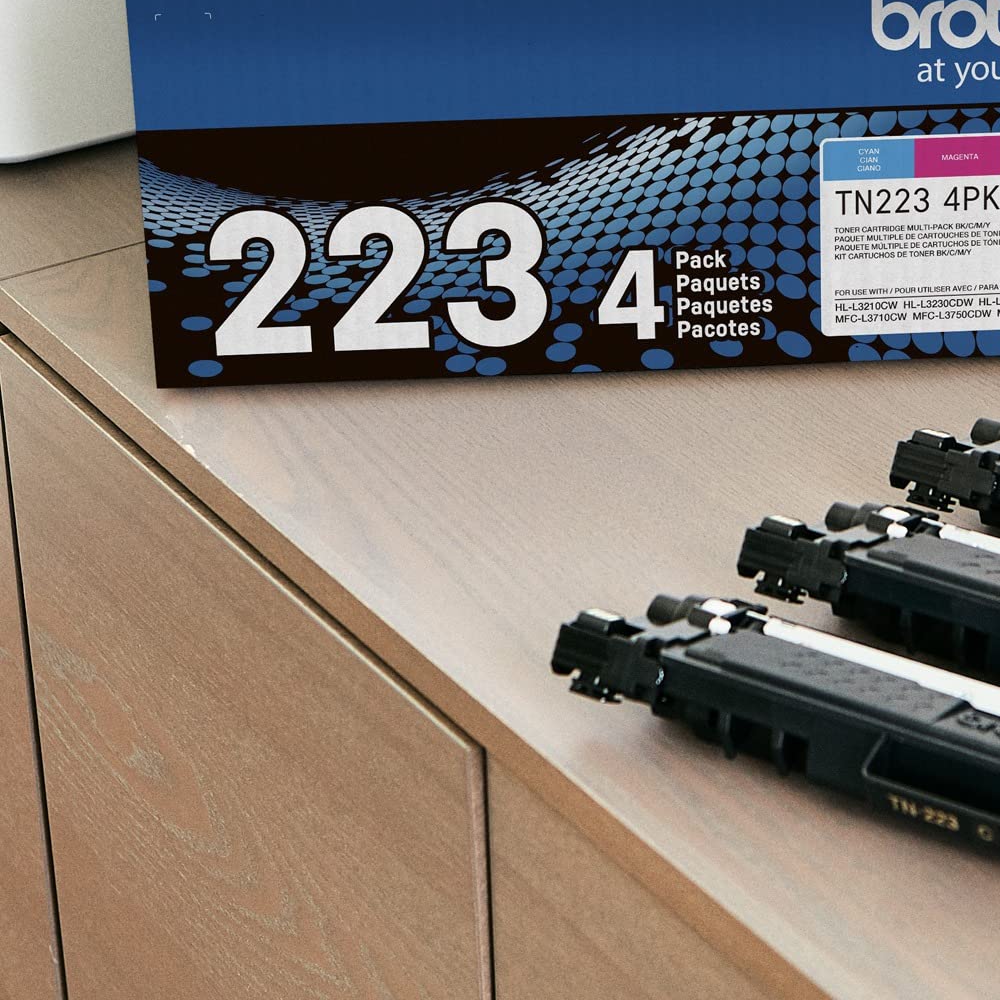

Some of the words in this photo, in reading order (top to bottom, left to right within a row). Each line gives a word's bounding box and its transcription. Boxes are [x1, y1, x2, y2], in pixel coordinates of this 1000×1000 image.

[917, 58, 946, 83] at
[858, 147, 881, 156] CYAN
[941, 153, 979, 161] MAGENTA
[859, 156, 879, 164] CIAN
[835, 187, 930, 216] TN223
[943, 184, 1000, 212] 4PK
[834, 226, 860, 234] TONER
[861, 224, 906, 233] CARTRIDGE
[907, 223, 953, 231] MULTI-PACK
[955, 222, 991, 230] BK/C/M/Y
[834, 234, 864, 242] PAQUET
[866, 233, 904, 241] MULTIPLE
[917, 231, 969, 239] CARTOUCHES
[834, 243, 870, 252] PAQUETE
[910, 241, 921, 249] DE
[922, 240, 969, 248] CARTUCHOS
[971, 239, 981, 247] DE
[675, 249, 727, 270] Pack
[847, 251, 896, 260] CARTUCHOS
[207, 200, 549, 356] 223
[676, 272, 761, 295] Paquets
[599, 249, 665, 340] 4
[834, 289, 851, 297] FOR
[852, 288, 867, 296] USE
[869, 287, 888, 295] WITH
[894, 286, 916, 294] POUR
[917, 285, 951, 293] UTILISER
[952, 284, 973, 292] AVEC
[978, 283, 999, 291] PARA
[677, 296, 773, 319] Paquetes
[835, 301, 898, 311] HL-L3210CW
[903, 298, 974, 309] HL-L3230CDW
[835, 312, 907, 323] MFC-L3710CW
[912, 309, 992, 320] MFC-L3750CDW
[677, 319, 761, 339] Pacotes
